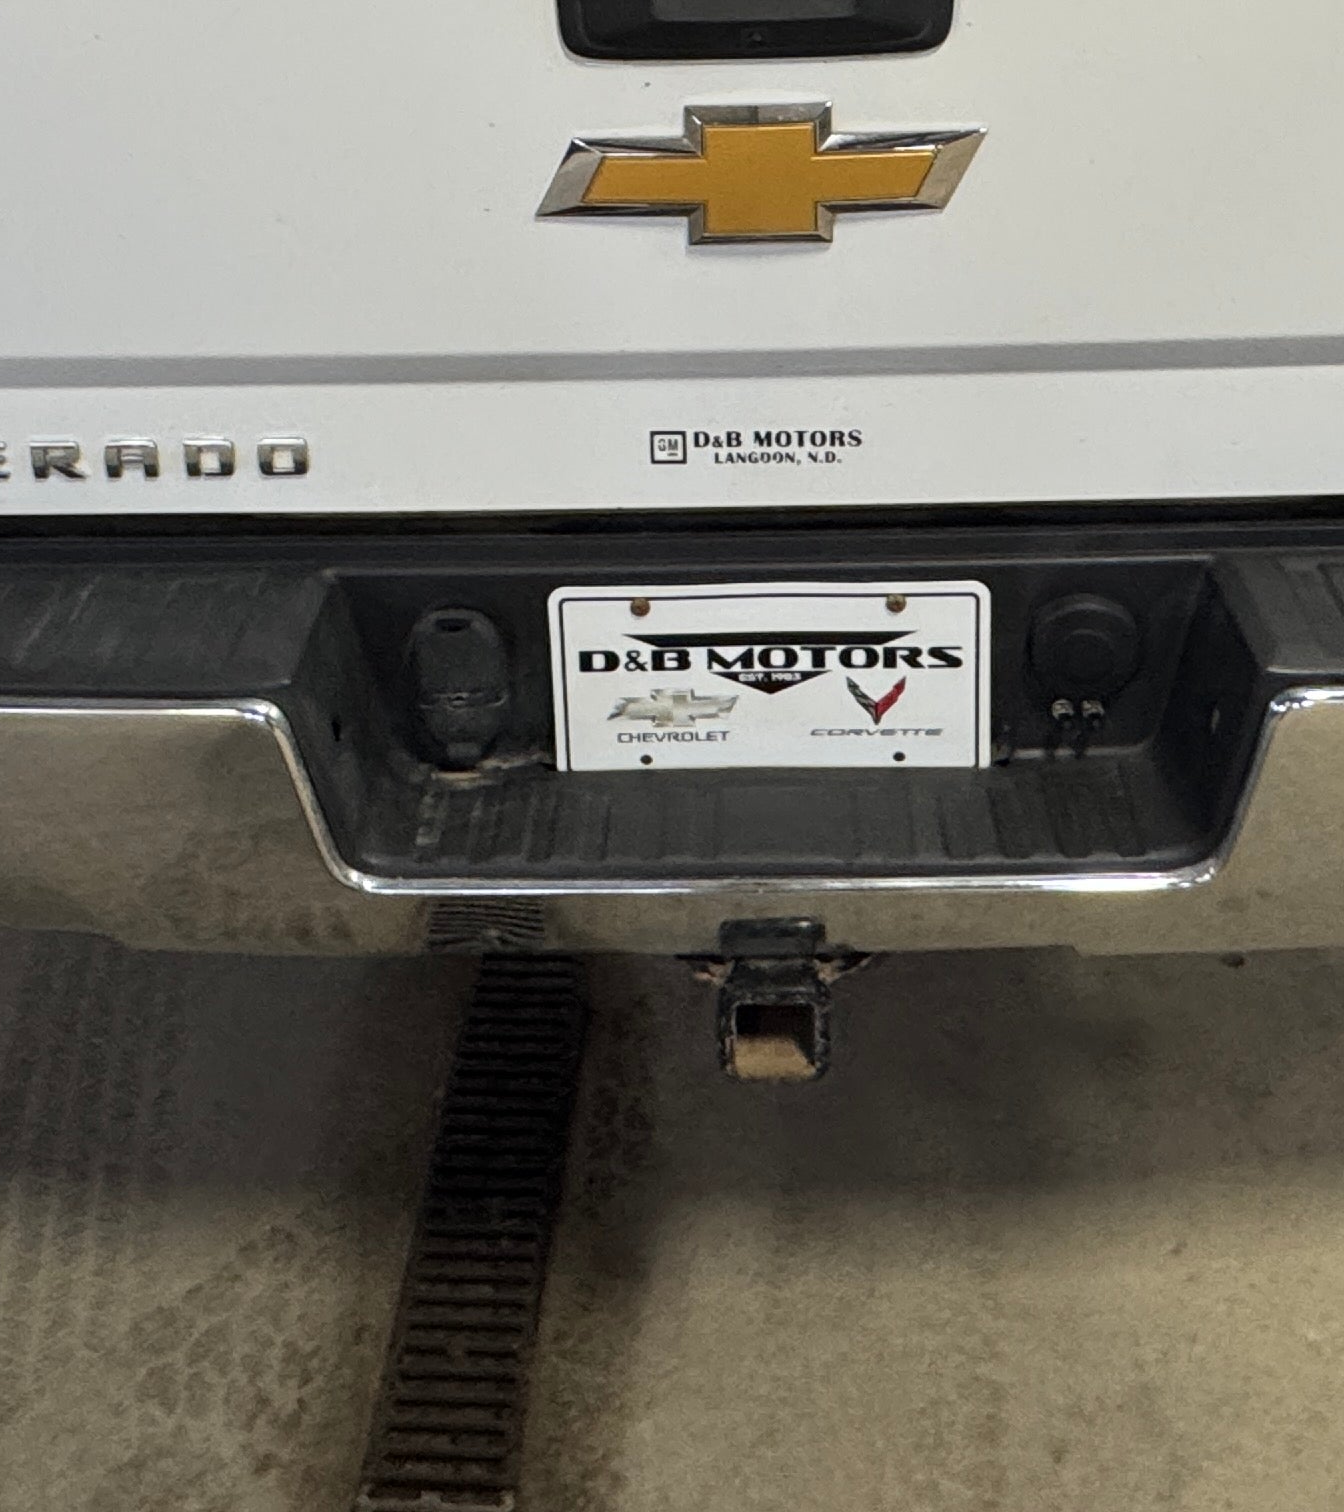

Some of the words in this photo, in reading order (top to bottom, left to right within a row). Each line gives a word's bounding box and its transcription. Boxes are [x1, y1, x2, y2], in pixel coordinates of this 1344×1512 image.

[692, 430, 743, 449] D&B
[752, 429, 863, 448] MOTORS
[807, 450, 843, 465] N.D.
[578, 648, 692, 673] D&B
[706, 645, 964, 671] MOTORS
[616, 729, 731, 744] CHEVROLET
[809, 727, 945, 737] CORVETTE
